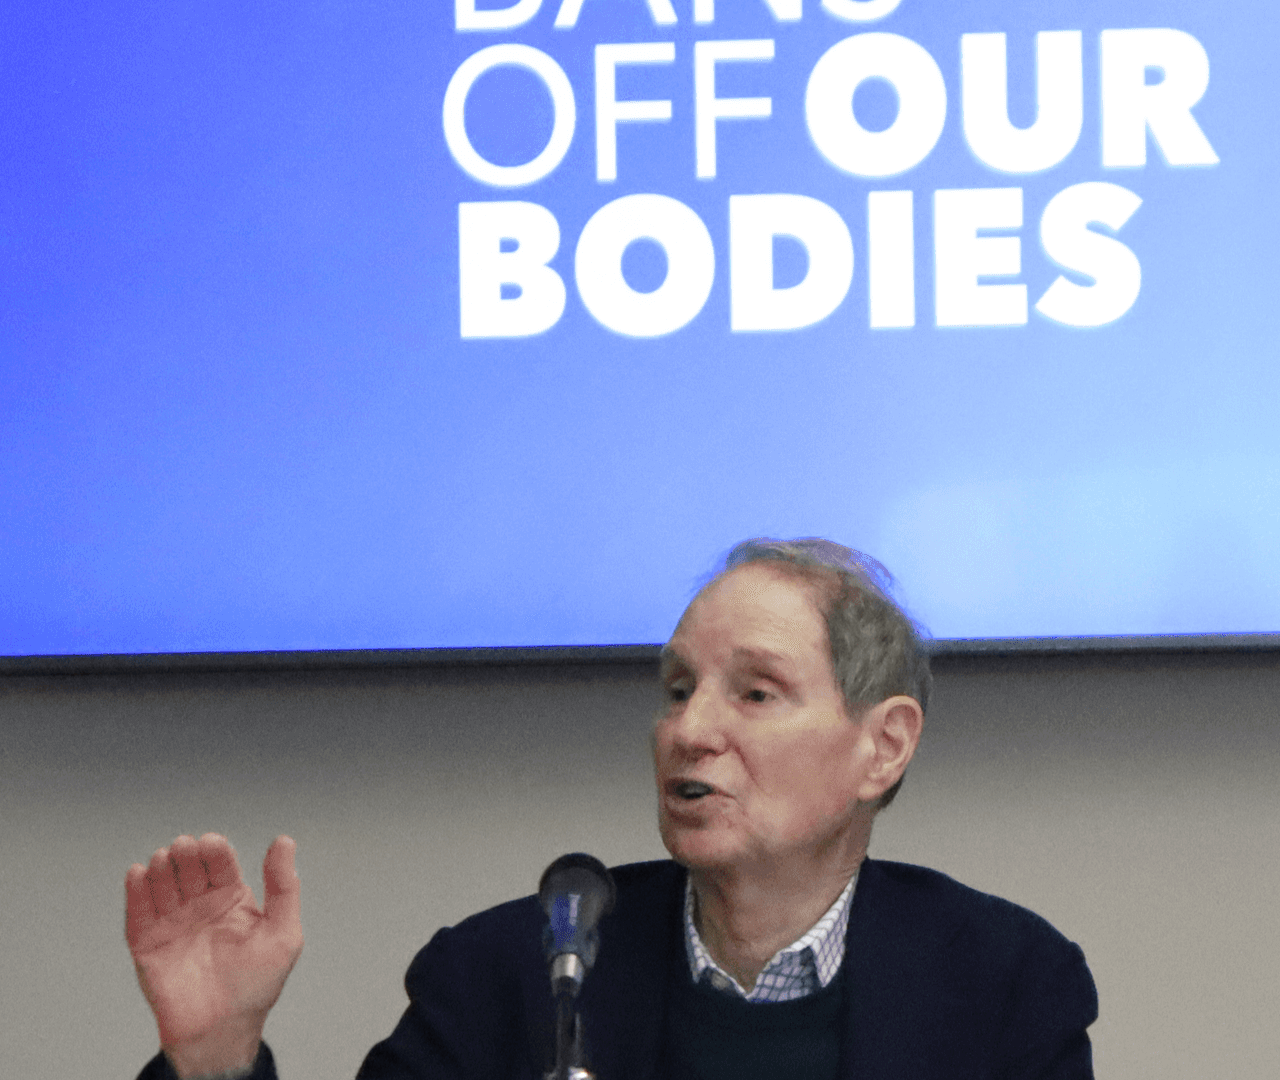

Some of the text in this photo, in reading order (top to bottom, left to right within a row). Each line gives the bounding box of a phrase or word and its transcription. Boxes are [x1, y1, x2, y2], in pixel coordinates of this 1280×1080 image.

[442, 28, 1220, 187] OFF OUR
[459, 181, 1144, 339] BODIES
